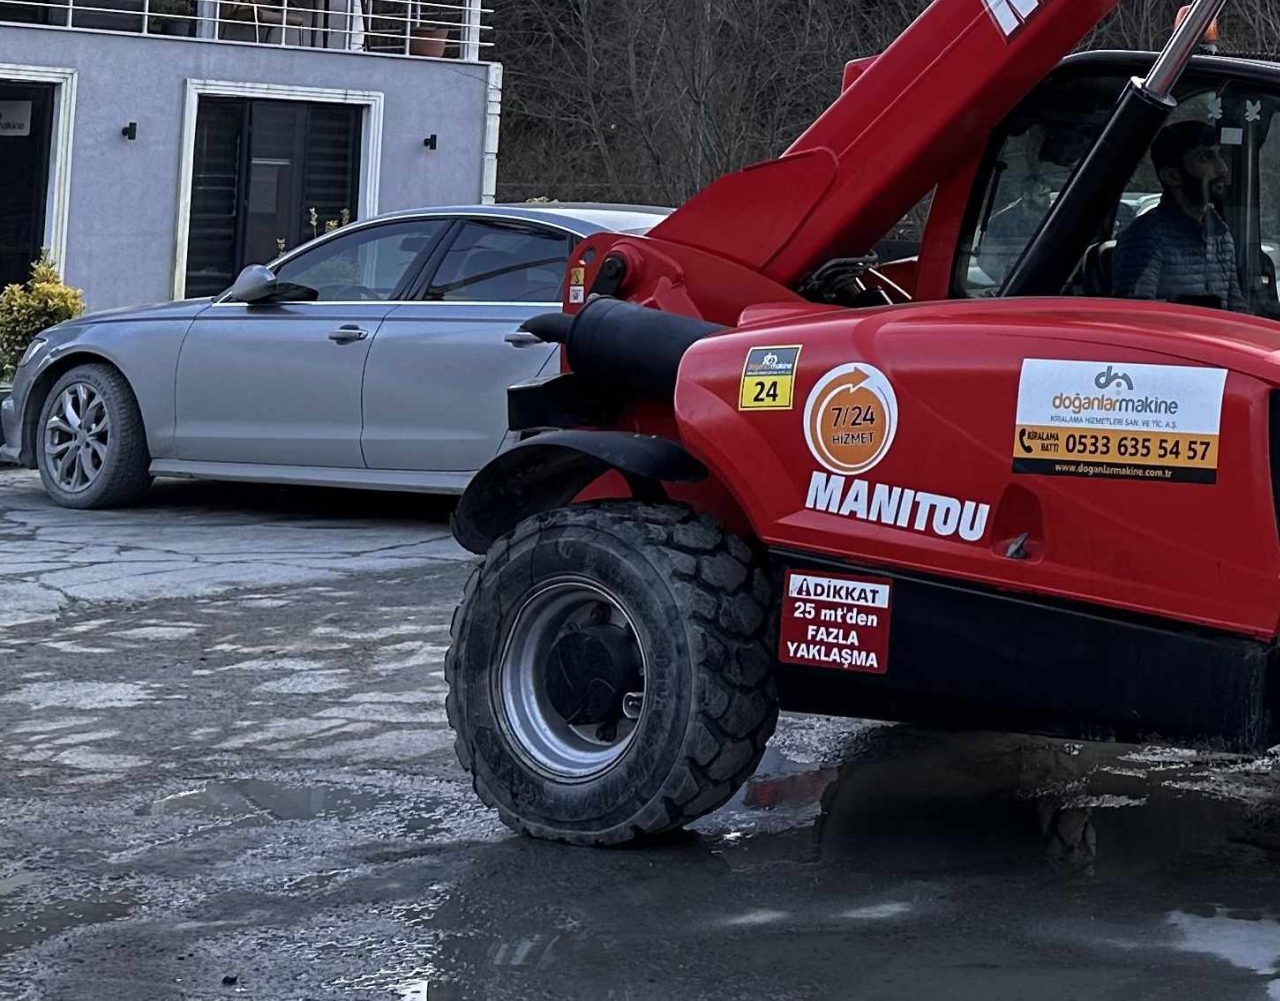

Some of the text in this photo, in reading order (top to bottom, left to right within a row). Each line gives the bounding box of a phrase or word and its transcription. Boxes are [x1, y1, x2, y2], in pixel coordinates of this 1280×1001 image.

[753, 381, 779, 402] 24
[1052, 392, 1178, 414] doğanlarmakine
[831, 405, 876, 428] 7/24
[1050, 414, 1084, 424] KİRALAMA
[1142, 420, 1151, 428] VE
[1027, 429, 1059, 441] KİRALAMA
[1065, 433, 1210, 461] 0533 635 54 57
[1055, 462, 1173, 479] www.doganlarmakine.com.tr
[804, 470, 990, 542] MANITOU
[813, 580, 880, 604] DİKKAT
[793, 601, 878, 627] 25 mt'den
[807, 625, 859, 646] FAZLA
[787, 641, 878, 668] YAKLAŞMA
